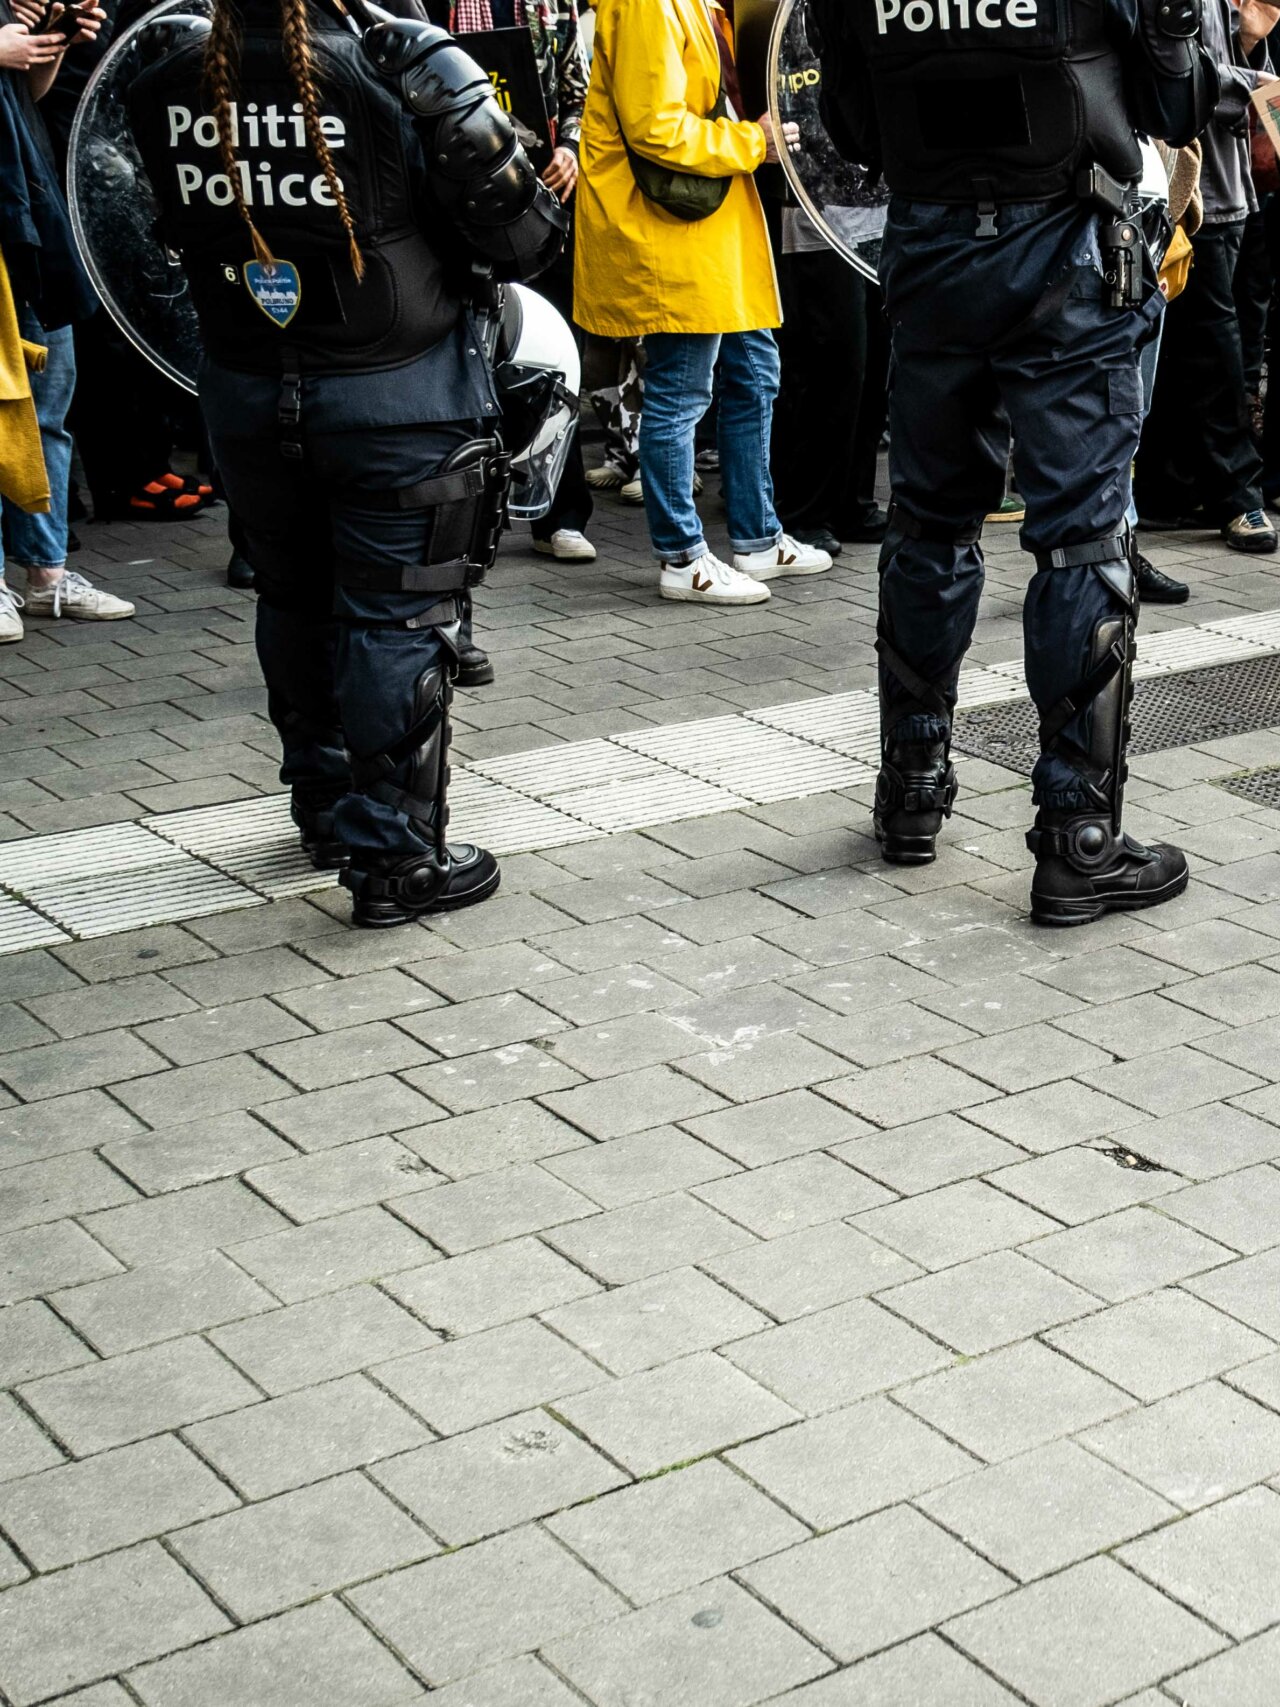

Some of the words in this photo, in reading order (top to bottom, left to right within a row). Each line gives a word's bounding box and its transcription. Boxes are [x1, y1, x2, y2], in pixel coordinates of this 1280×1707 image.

[875, 0, 1038, 35] Police
[167, 102, 346, 148] Politie
[176, 161, 345, 206] Police
[225, 266, 236, 282] 6
